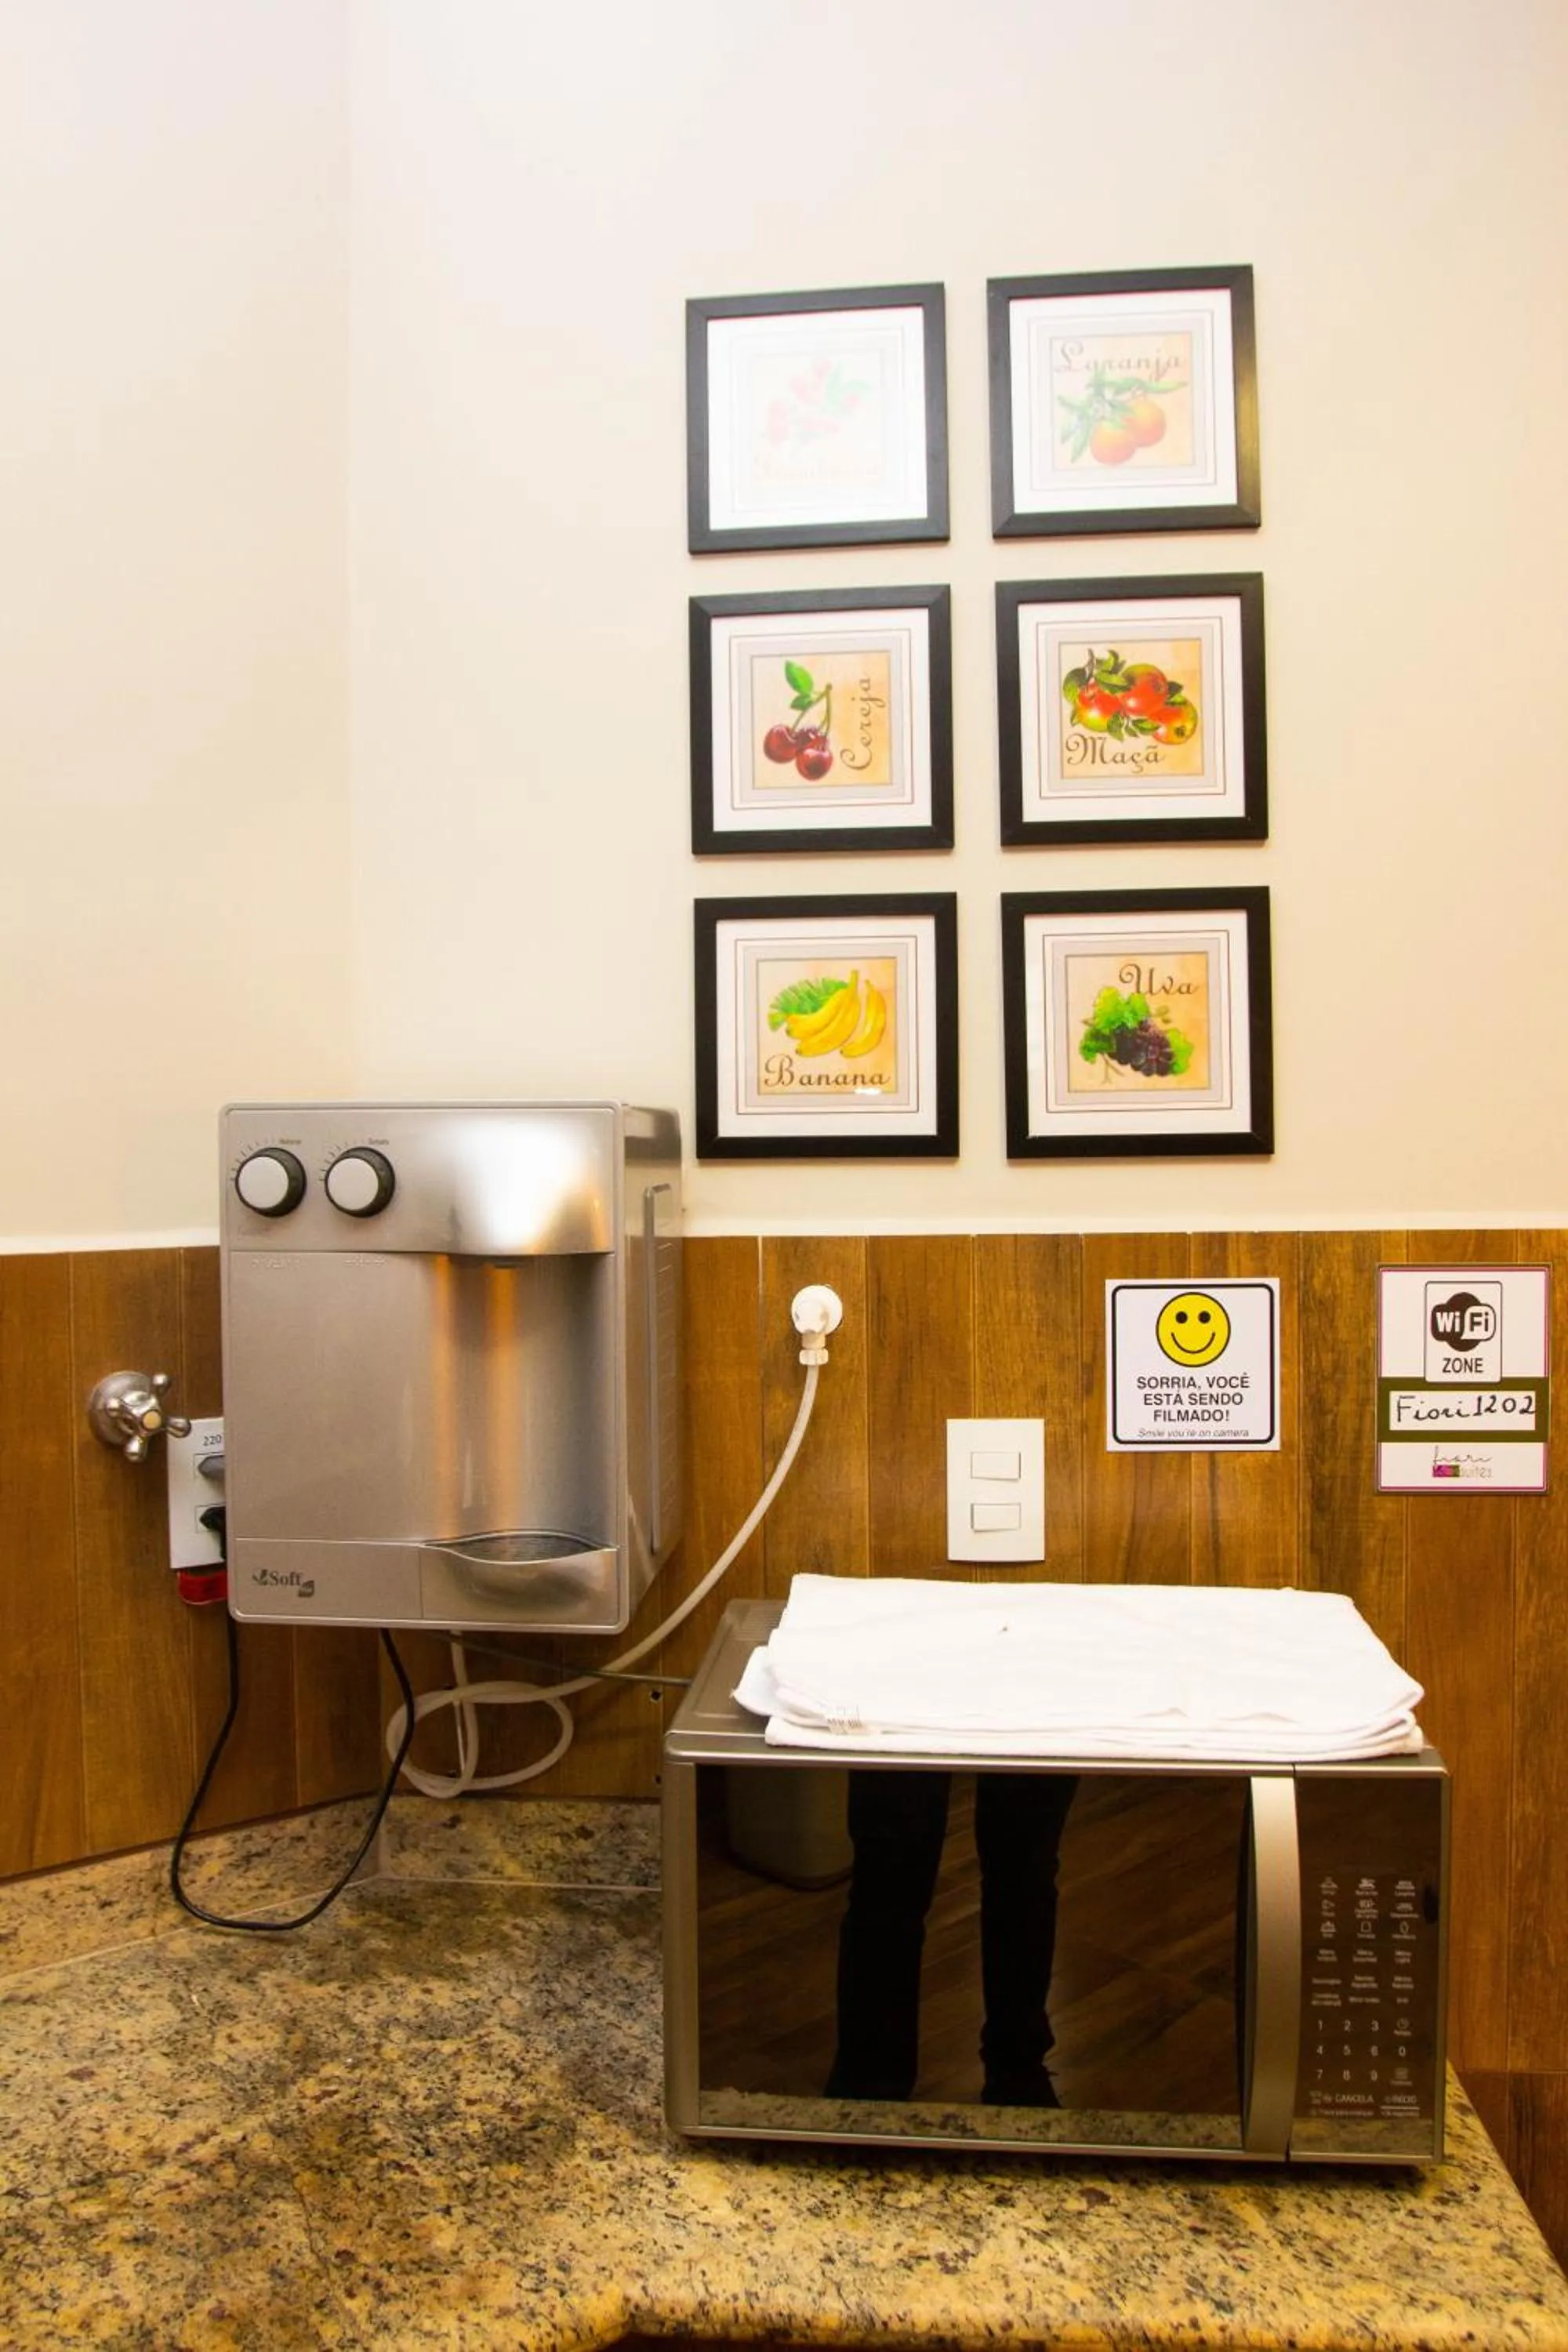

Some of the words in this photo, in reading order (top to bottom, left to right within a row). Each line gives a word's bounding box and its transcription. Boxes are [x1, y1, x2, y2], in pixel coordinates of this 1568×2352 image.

[1054, 341, 1180, 382] Laranja
[840, 677, 886, 771] Cereja
[1066, 733, 1166, 773] Maçã
[1119, 964, 1200, 996] Uva
[764, 1054, 891, 1087] Banana
[1442, 1357, 1483, 1373] ZONE
[1137, 1376, 1201, 1391] SORRIA,
[1206, 1372, 1250, 1388] VOCÊ
[1143, 1390, 1183, 1406] ESTÁ
[1188, 1392, 1243, 1406] SENDO
[1153, 1410, 1230, 1421] FILMADO!
[203, 1434, 222, 1446] 220
